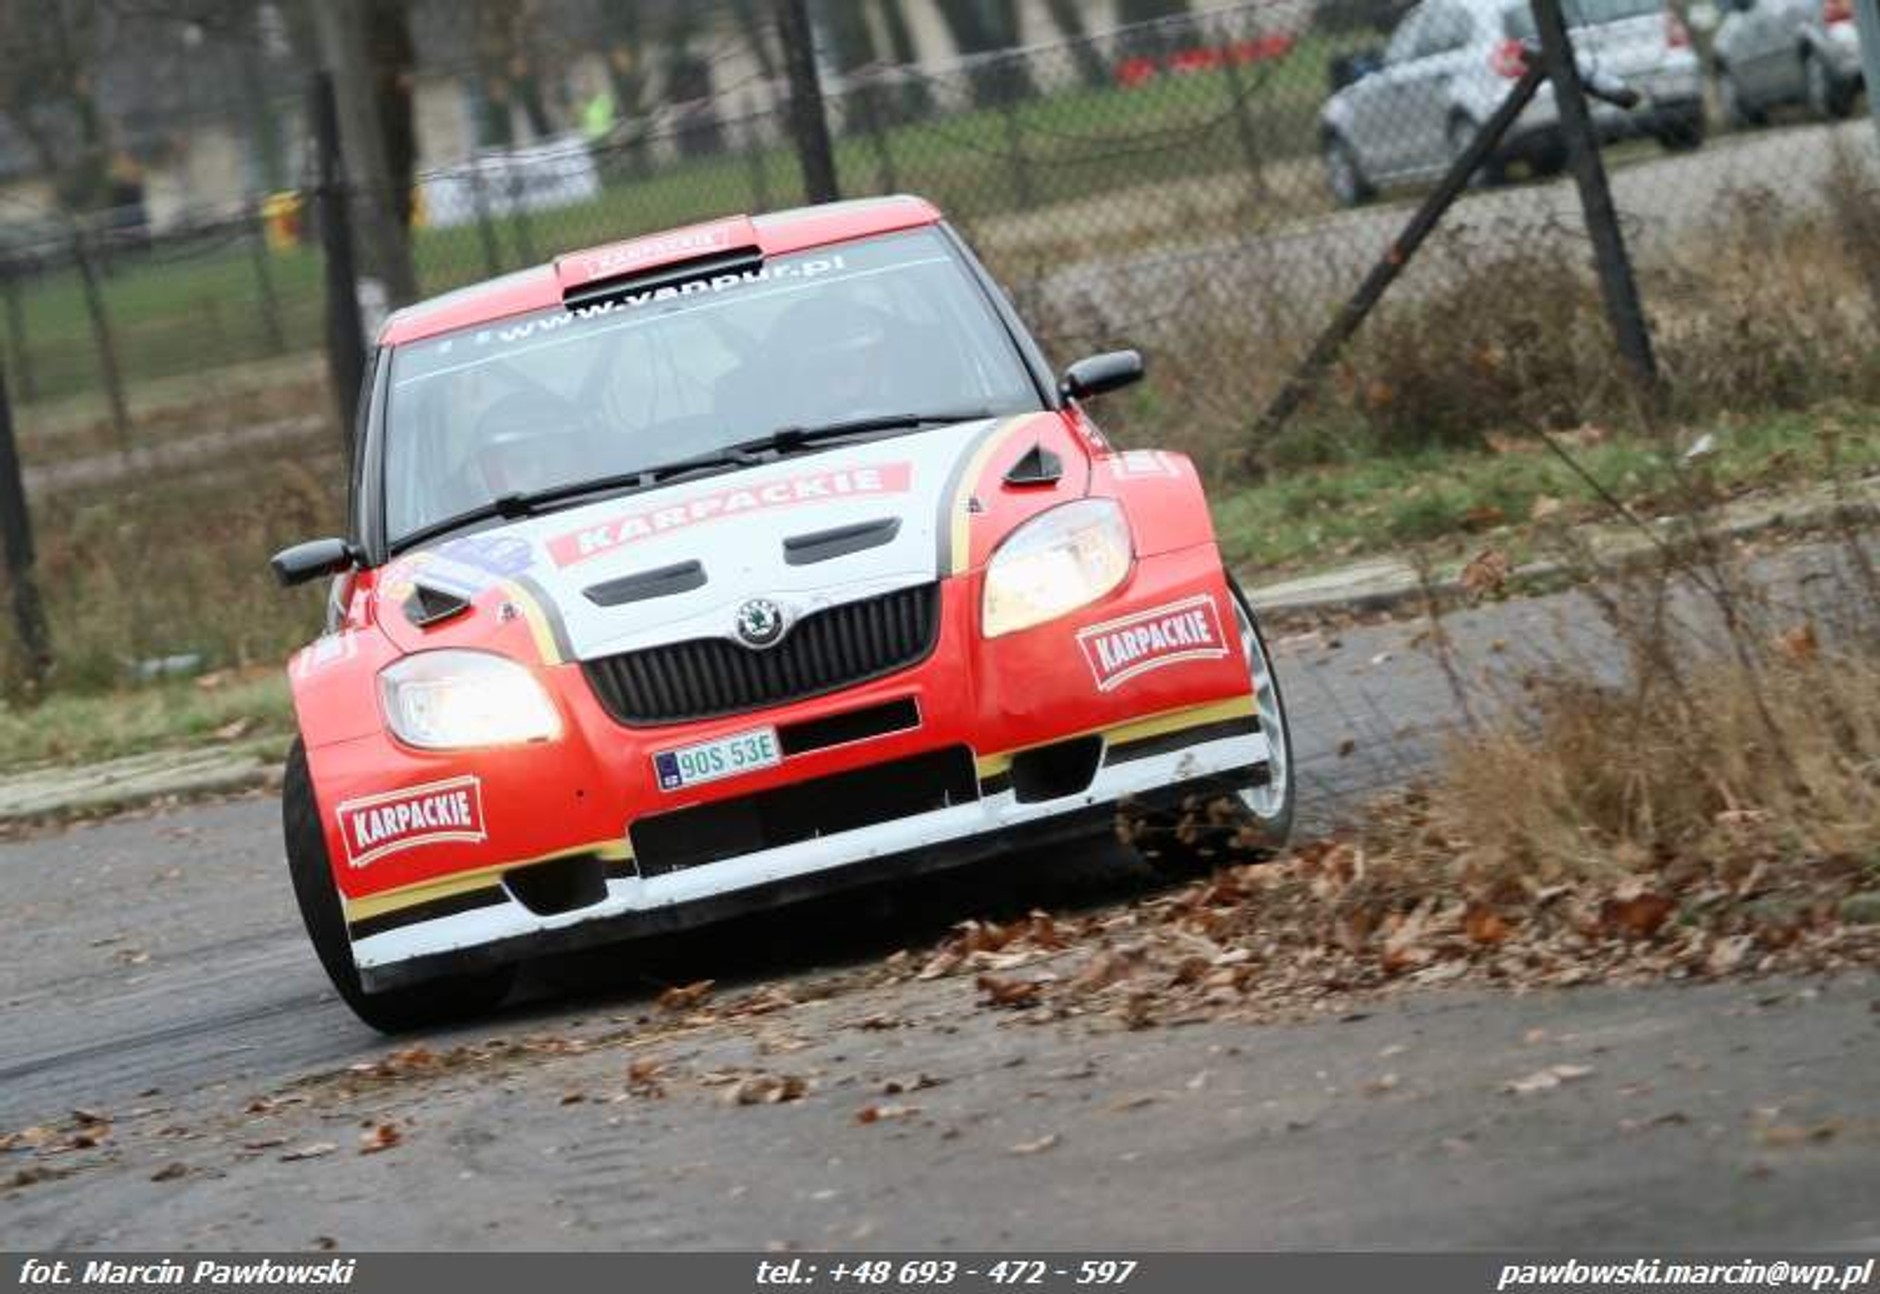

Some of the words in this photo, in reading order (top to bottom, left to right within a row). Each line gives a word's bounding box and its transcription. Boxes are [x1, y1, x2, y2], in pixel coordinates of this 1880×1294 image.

[577, 468, 884, 552] KARPACKIE
[1094, 609, 1212, 672] KARPACKIE
[680, 746, 724, 778] 90S
[729, 734, 773, 766] 53E
[351, 791, 471, 848] KARPACKIE
